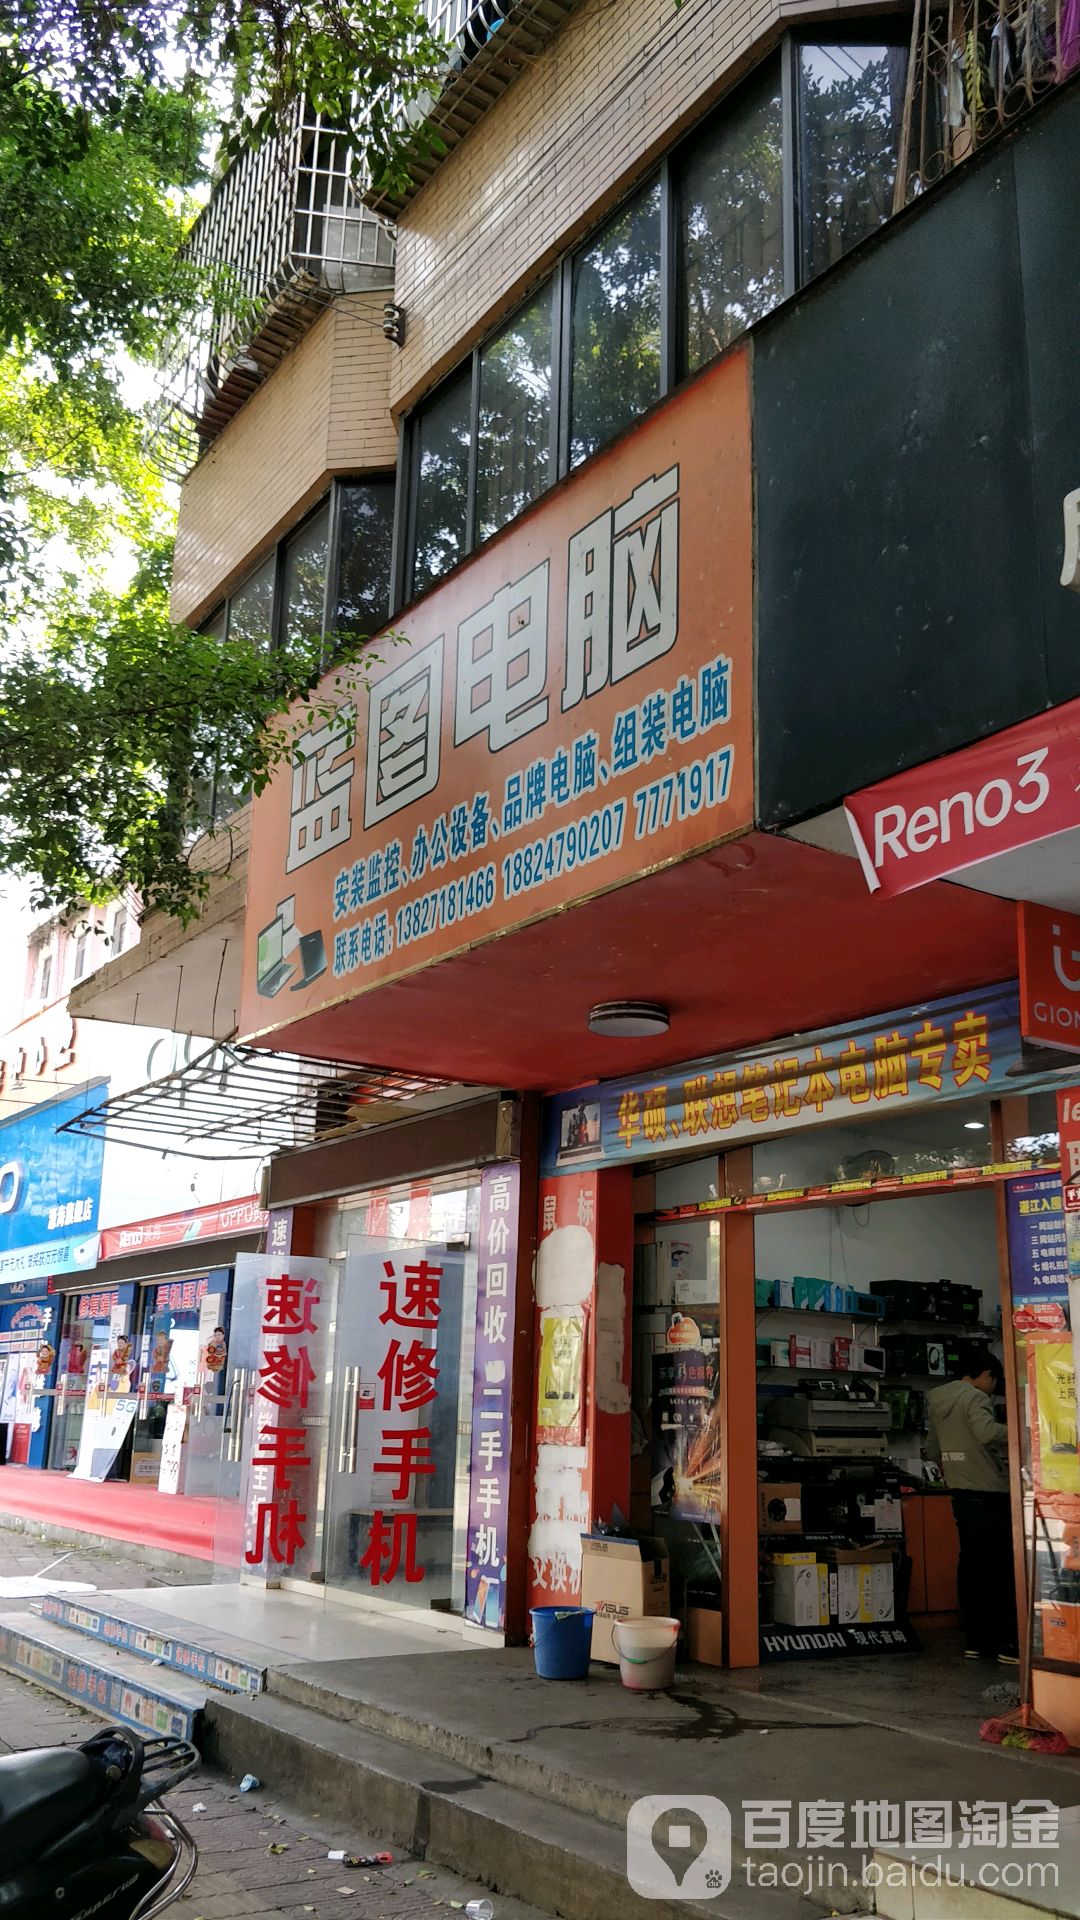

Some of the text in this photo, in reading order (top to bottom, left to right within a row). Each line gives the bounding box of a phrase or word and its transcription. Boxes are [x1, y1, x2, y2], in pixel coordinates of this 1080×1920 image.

[286, 463, 680, 874] 蓝图电脑
[332, 654, 733, 918] 安装监控、办公设备、品牌电脑、组装电脑
[502, 803, 625, 900] 18824790207
[633, 746, 735, 842] 7771917
[874, 746, 1050, 868] Reno3
[615, 1010, 992, 1151] 华硕、联想笔记本电脑专卖
[115, 1400, 138, 1413] 5G
[361, 1260, 443, 1586] 速修手机
[475, 1174, 511, 1567] 高价回收二手手机
[594, 1600, 630, 1617] ASUS
[764, 1629, 907, 1652] HYUNDAI 现代音响
